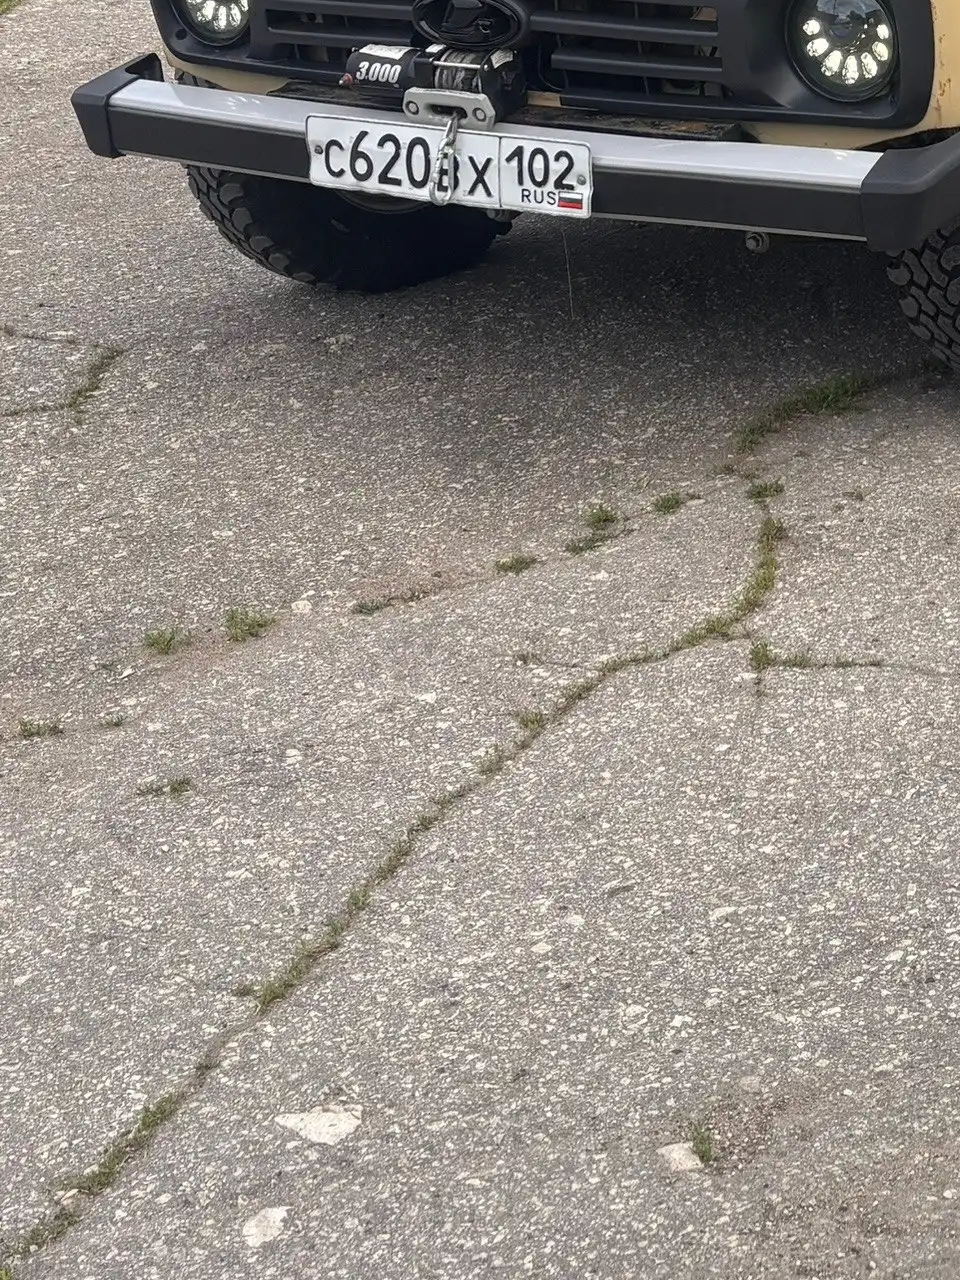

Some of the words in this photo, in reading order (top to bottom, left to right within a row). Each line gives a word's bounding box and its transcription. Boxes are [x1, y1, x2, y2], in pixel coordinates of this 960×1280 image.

[355, 60, 402, 84] 3.000
[504, 145, 576, 191] 102
[520, 188, 557, 206] RUS
